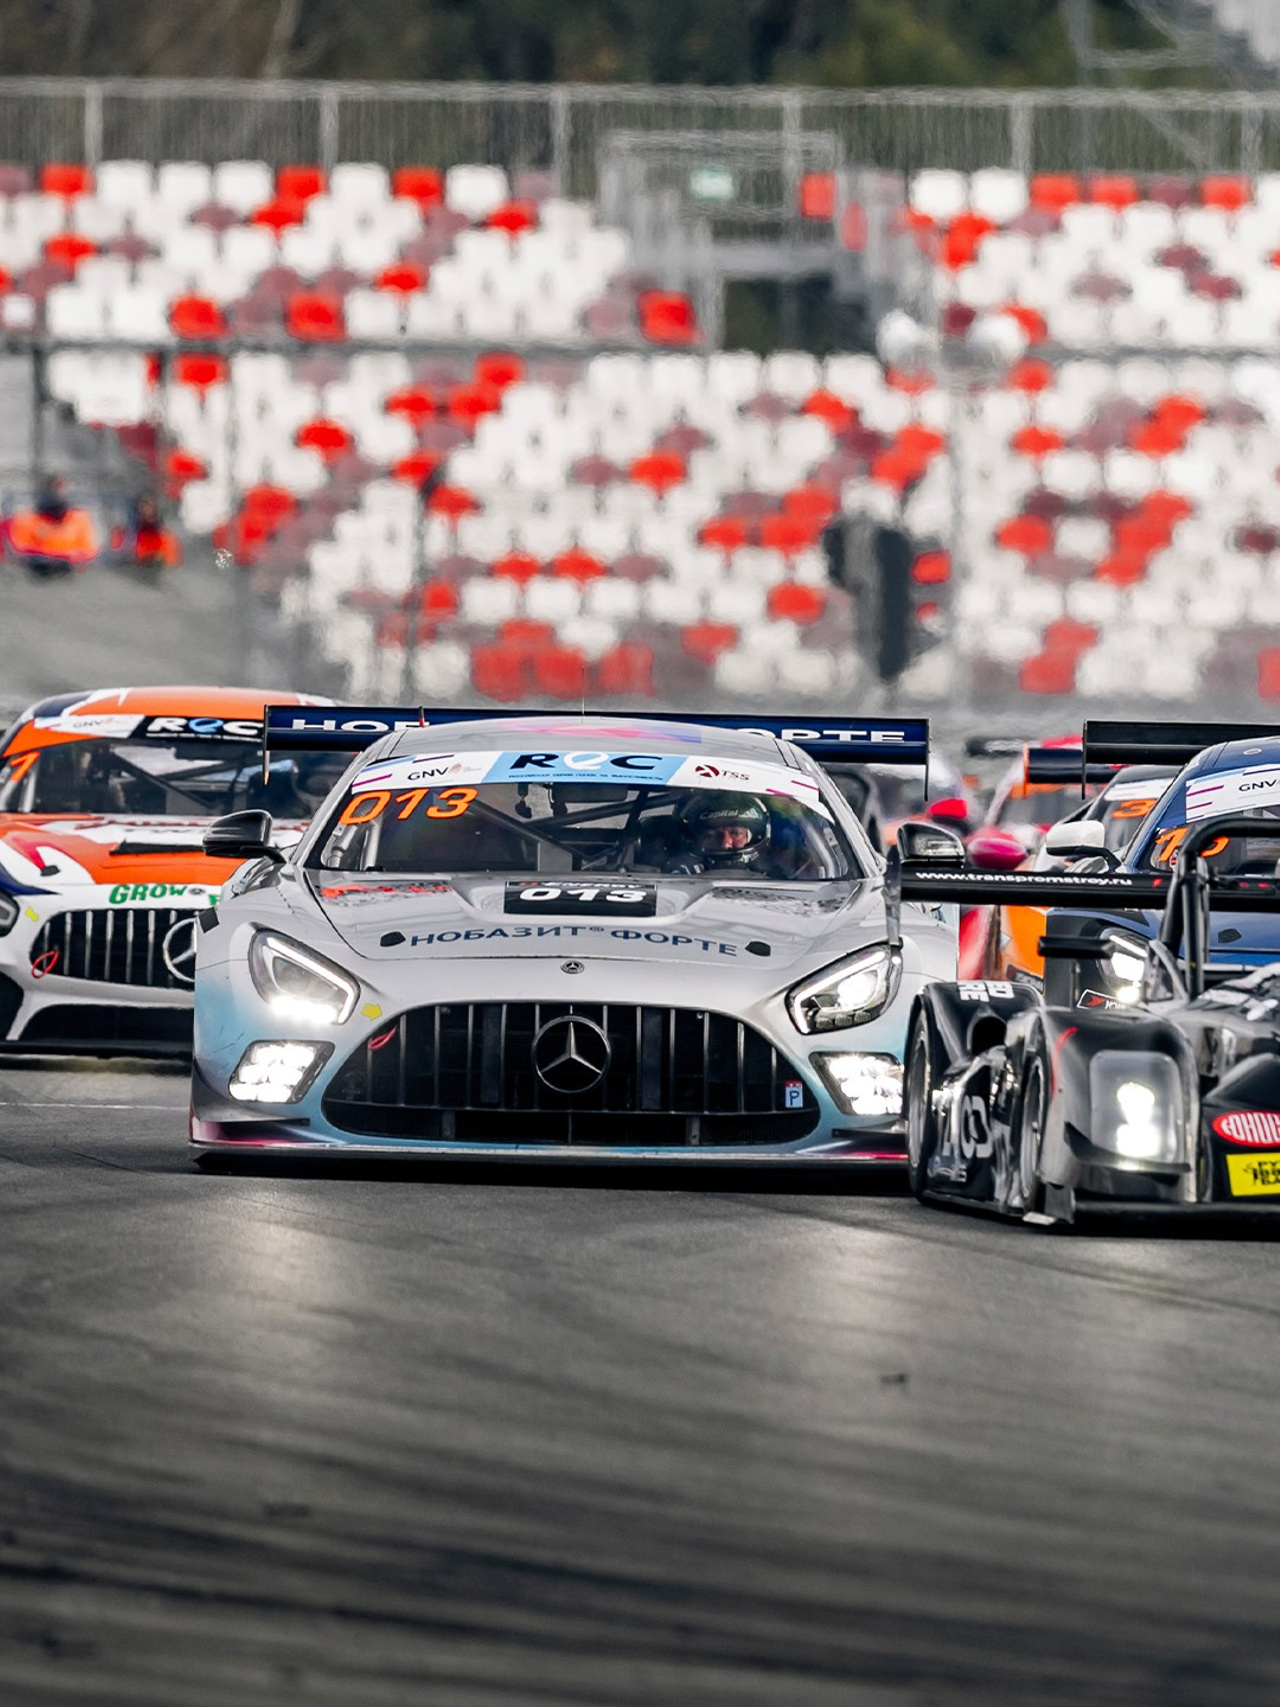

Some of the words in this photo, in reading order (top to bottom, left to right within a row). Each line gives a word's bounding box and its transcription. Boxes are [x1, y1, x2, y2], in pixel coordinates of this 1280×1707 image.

[407, 766, 449, 781] GNV
[720, 770, 750, 781] TSS
[1239, 779, 1277, 792] GNV
[339, 787, 479, 826] 013
[915, 872, 1133, 886] www.transpromstroy.ru
[519, 887, 647, 902] 013
[611, 929, 737, 957] ФОРТЕ
